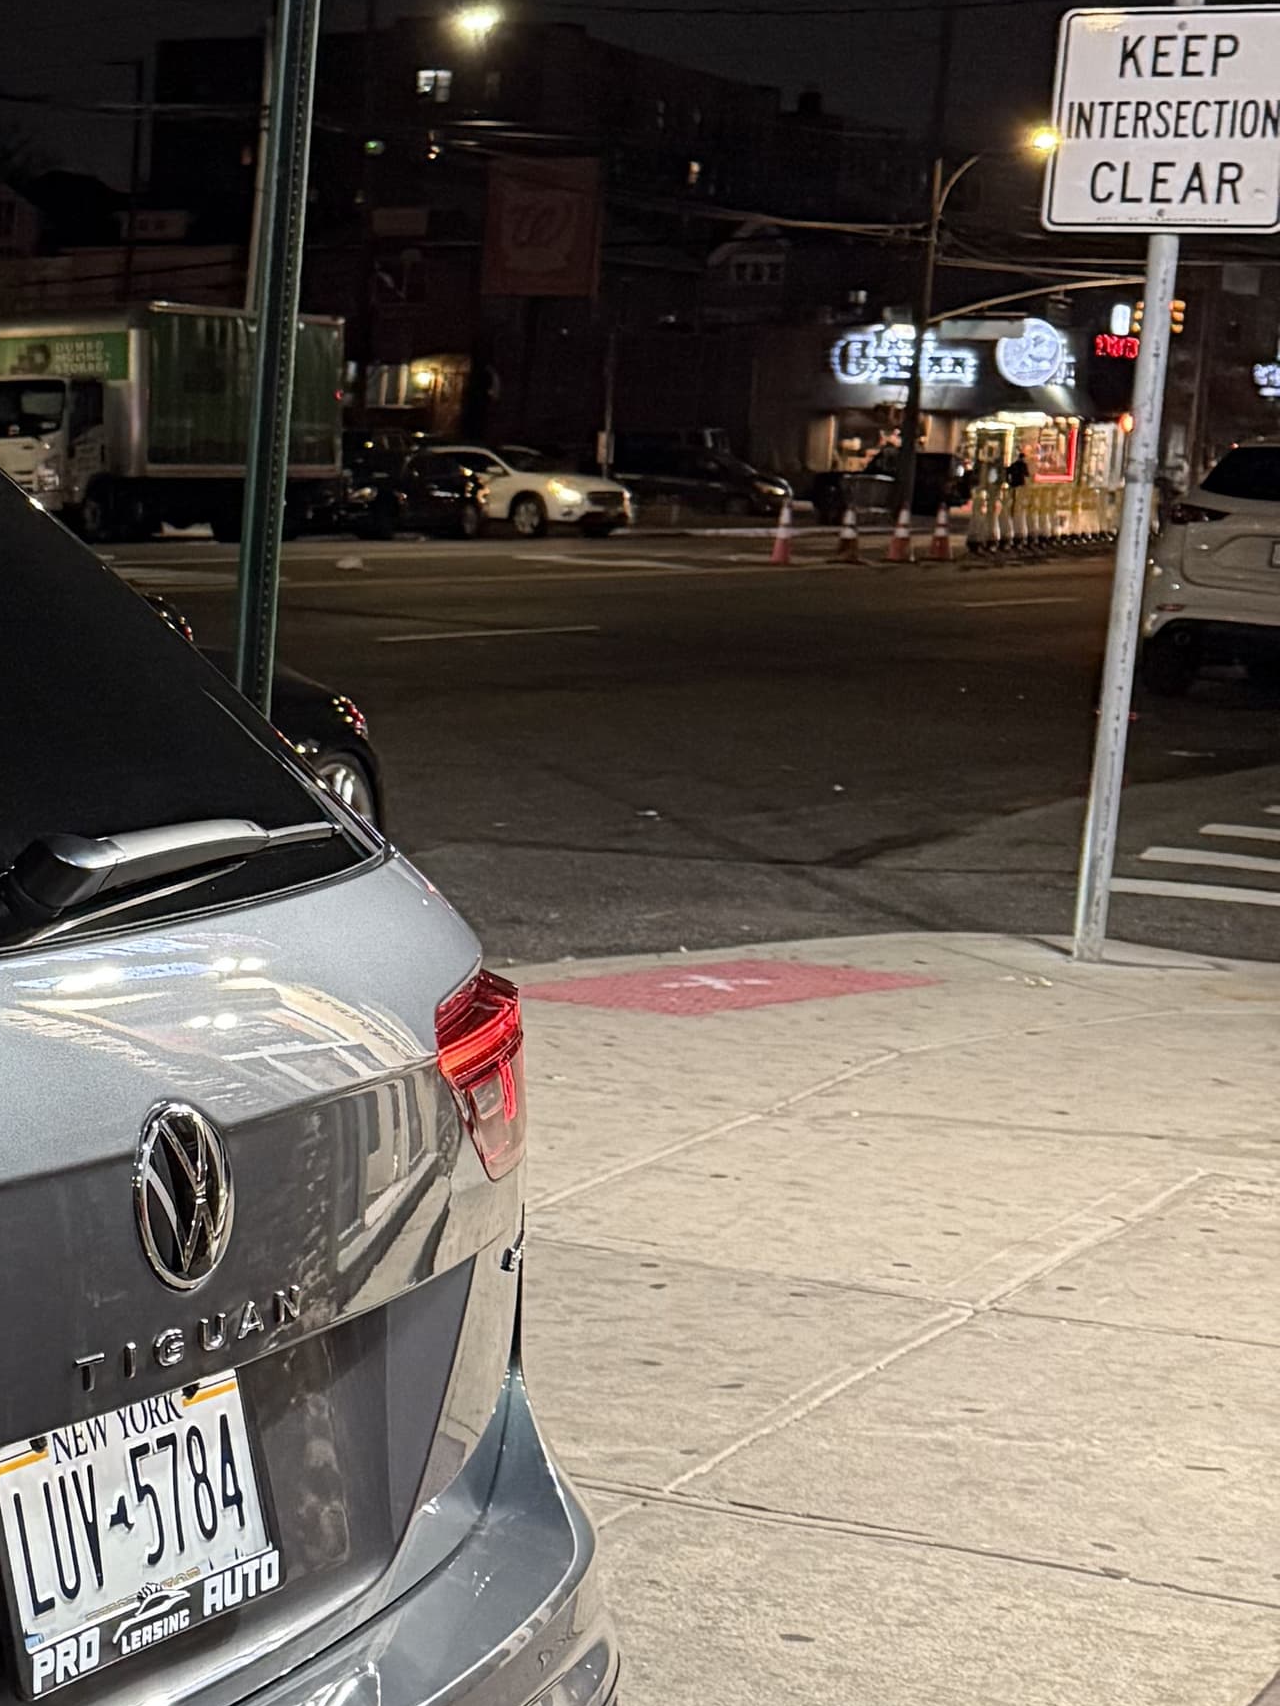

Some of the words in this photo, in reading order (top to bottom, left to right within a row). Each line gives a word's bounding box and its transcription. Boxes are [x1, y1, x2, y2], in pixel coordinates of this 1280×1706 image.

[1118, 33, 1240, 79] KEEP
[1066, 99, 1280, 139] INTERSECTION
[1089, 160, 1244, 205] CLEAR
[74, 1284, 301, 1391] TIGUAN
[51, 1413, 108, 1465] NEW
[116, 1392, 183, 1440] YORK
[13, 1463, 104, 1617] LUV
[128, 1412, 245, 1566] 5784
[202, 1549, 280, 1617] AUTO
[31, 1626, 101, 1695] PRO
[121, 1608, 191, 1655] LEASING
